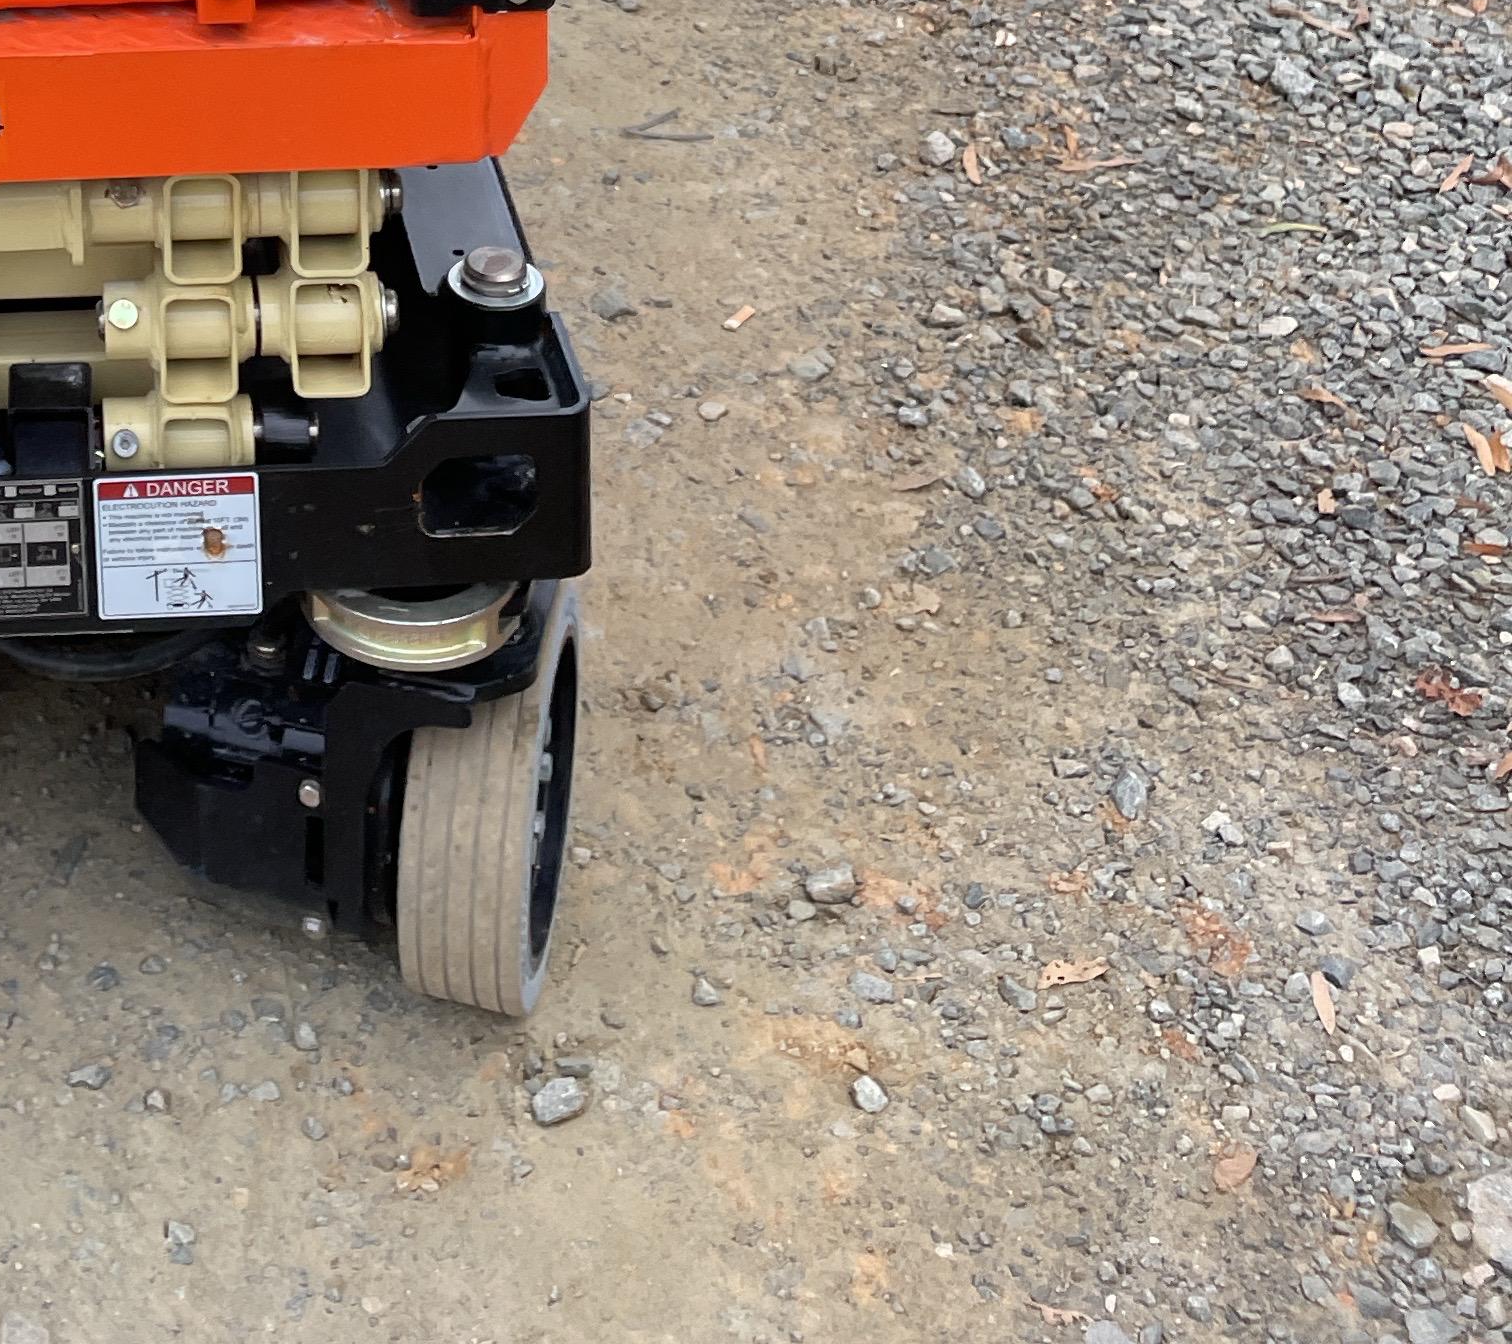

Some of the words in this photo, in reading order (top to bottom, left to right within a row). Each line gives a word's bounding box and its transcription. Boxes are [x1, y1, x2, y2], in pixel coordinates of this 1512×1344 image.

[146, 479, 230, 497] DANGER
[101, 501, 178, 512] ELECTROCUTION
[179, 499, 217, 508] HAZARD
